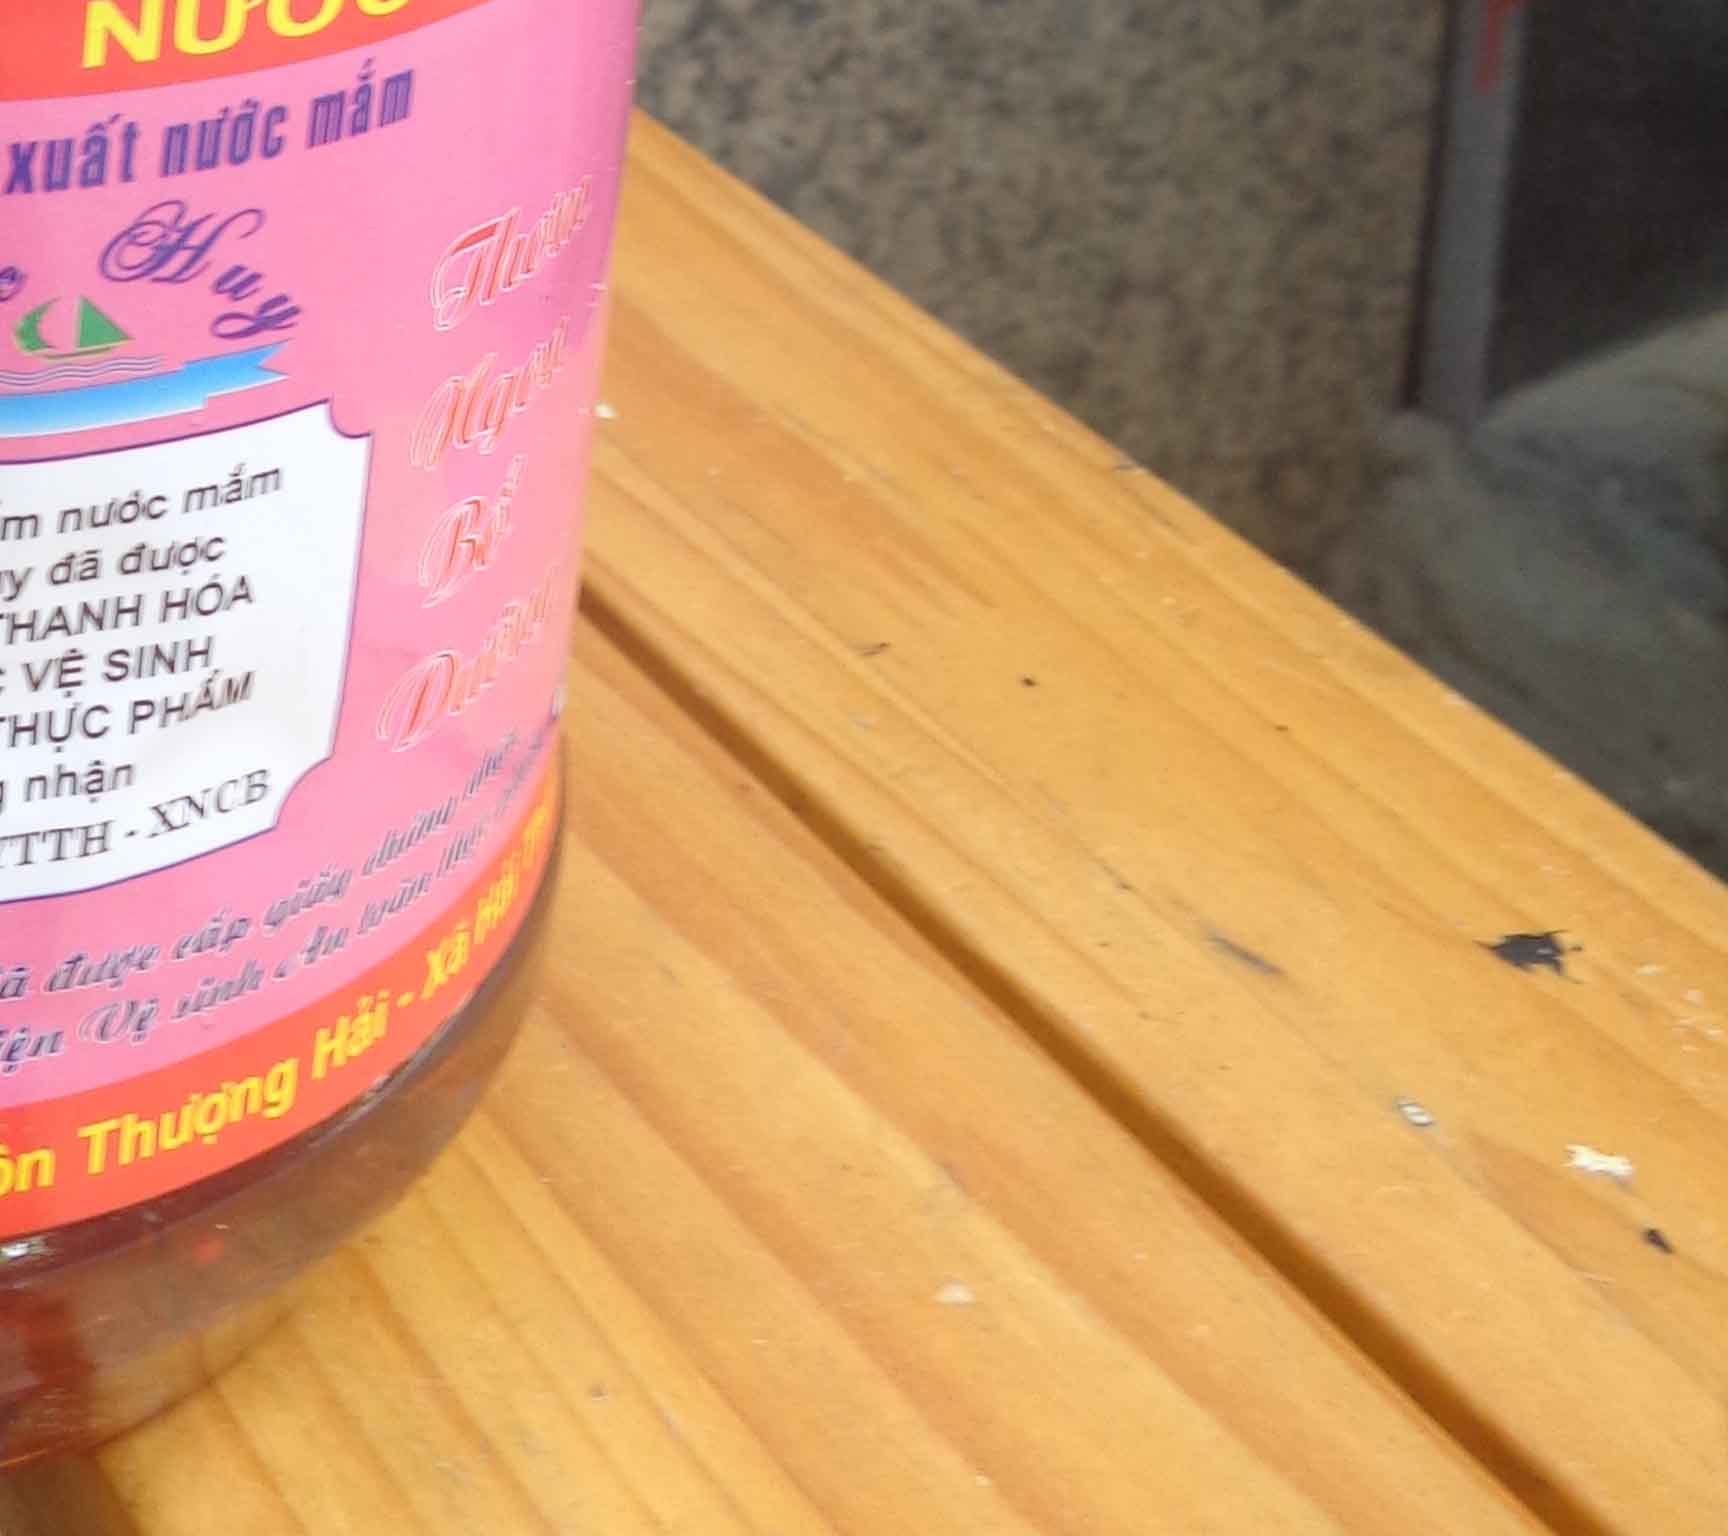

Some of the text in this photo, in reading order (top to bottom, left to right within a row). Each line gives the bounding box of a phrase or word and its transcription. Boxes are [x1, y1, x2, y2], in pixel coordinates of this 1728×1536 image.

[3, 114, 141, 196] xuất
[159, 98, 287, 179] nước
[306, 58, 415, 150] mắm
[98, 200, 303, 340] Huy
[56, 490, 169, 536] nước
[182, 462, 282, 515] mắm
[48, 548, 102, 587] đã
[119, 534, 228, 576] được
[159, 574, 257, 624] HÓA
[22, 649, 86, 698] VỆ
[103, 635, 215, 683] SINH
[23, 759, 136, 802] nhận
[148, 768, 272, 840] XNCB
[76, 1058, 301, 1177] Thượng
